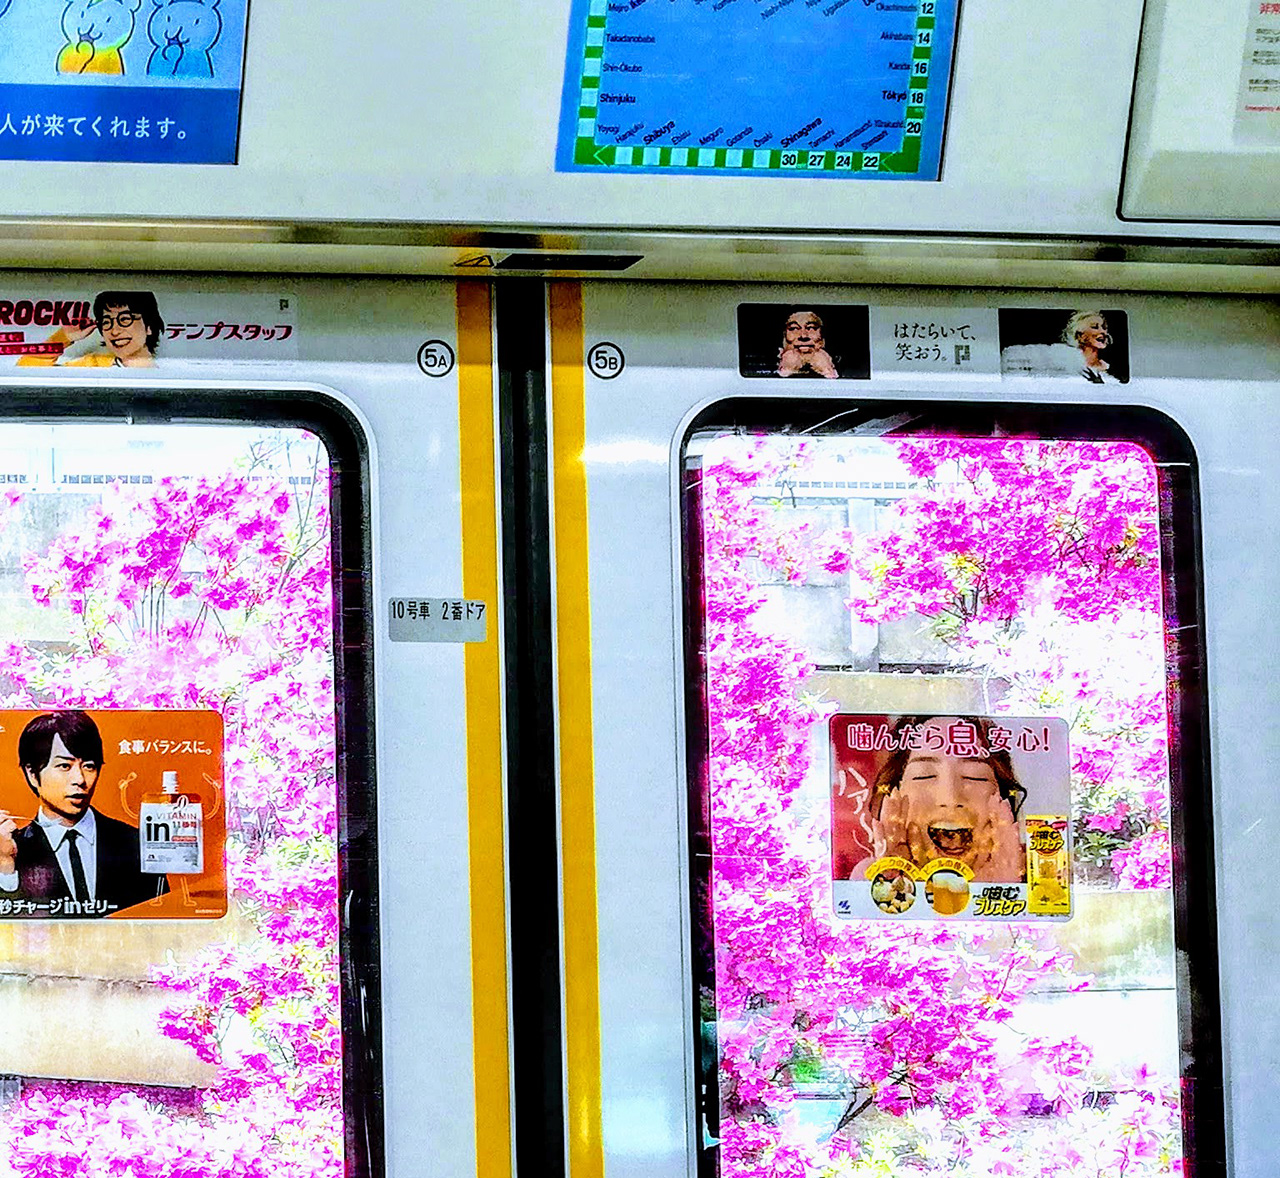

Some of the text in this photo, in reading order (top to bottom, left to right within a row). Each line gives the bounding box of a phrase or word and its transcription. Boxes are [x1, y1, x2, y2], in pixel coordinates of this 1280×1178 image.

[921, 3, 934, 14] 12
[918, 33, 930, 44] 14
[914, 62, 927, 74] 16
[599, 93, 636, 105] Shinjuku
[911, 92, 924, 104] 18
[597, 123, 620, 136] Yoyogi
[642, 120, 676, 146] Shibuya
[698, 126, 724, 146] Meguro
[780, 117, 823, 149] Shinagawa
[906, 121, 921, 134] 20
[781, 153, 797, 166] 30
[809, 154, 824, 166] 27
[836, 155, 851, 167] 24
[863, 156, 879, 168] 22
[165, 321, 293, 341] テンプスタッフ
[894, 322, 976, 341] はたらいて、
[423, 348, 447, 368] 5A
[594, 350, 619, 371] 5B
[895, 342, 948, 362] 笑おう。
[391, 601, 487, 621] 10号車 2番ドア
[118, 738, 212, 755] 食事バランスに。
[847, 719, 1052, 758] 噛んだら息、安心!
[145, 816, 170, 841] in
[972, 899, 1027, 916] ブレスケア
